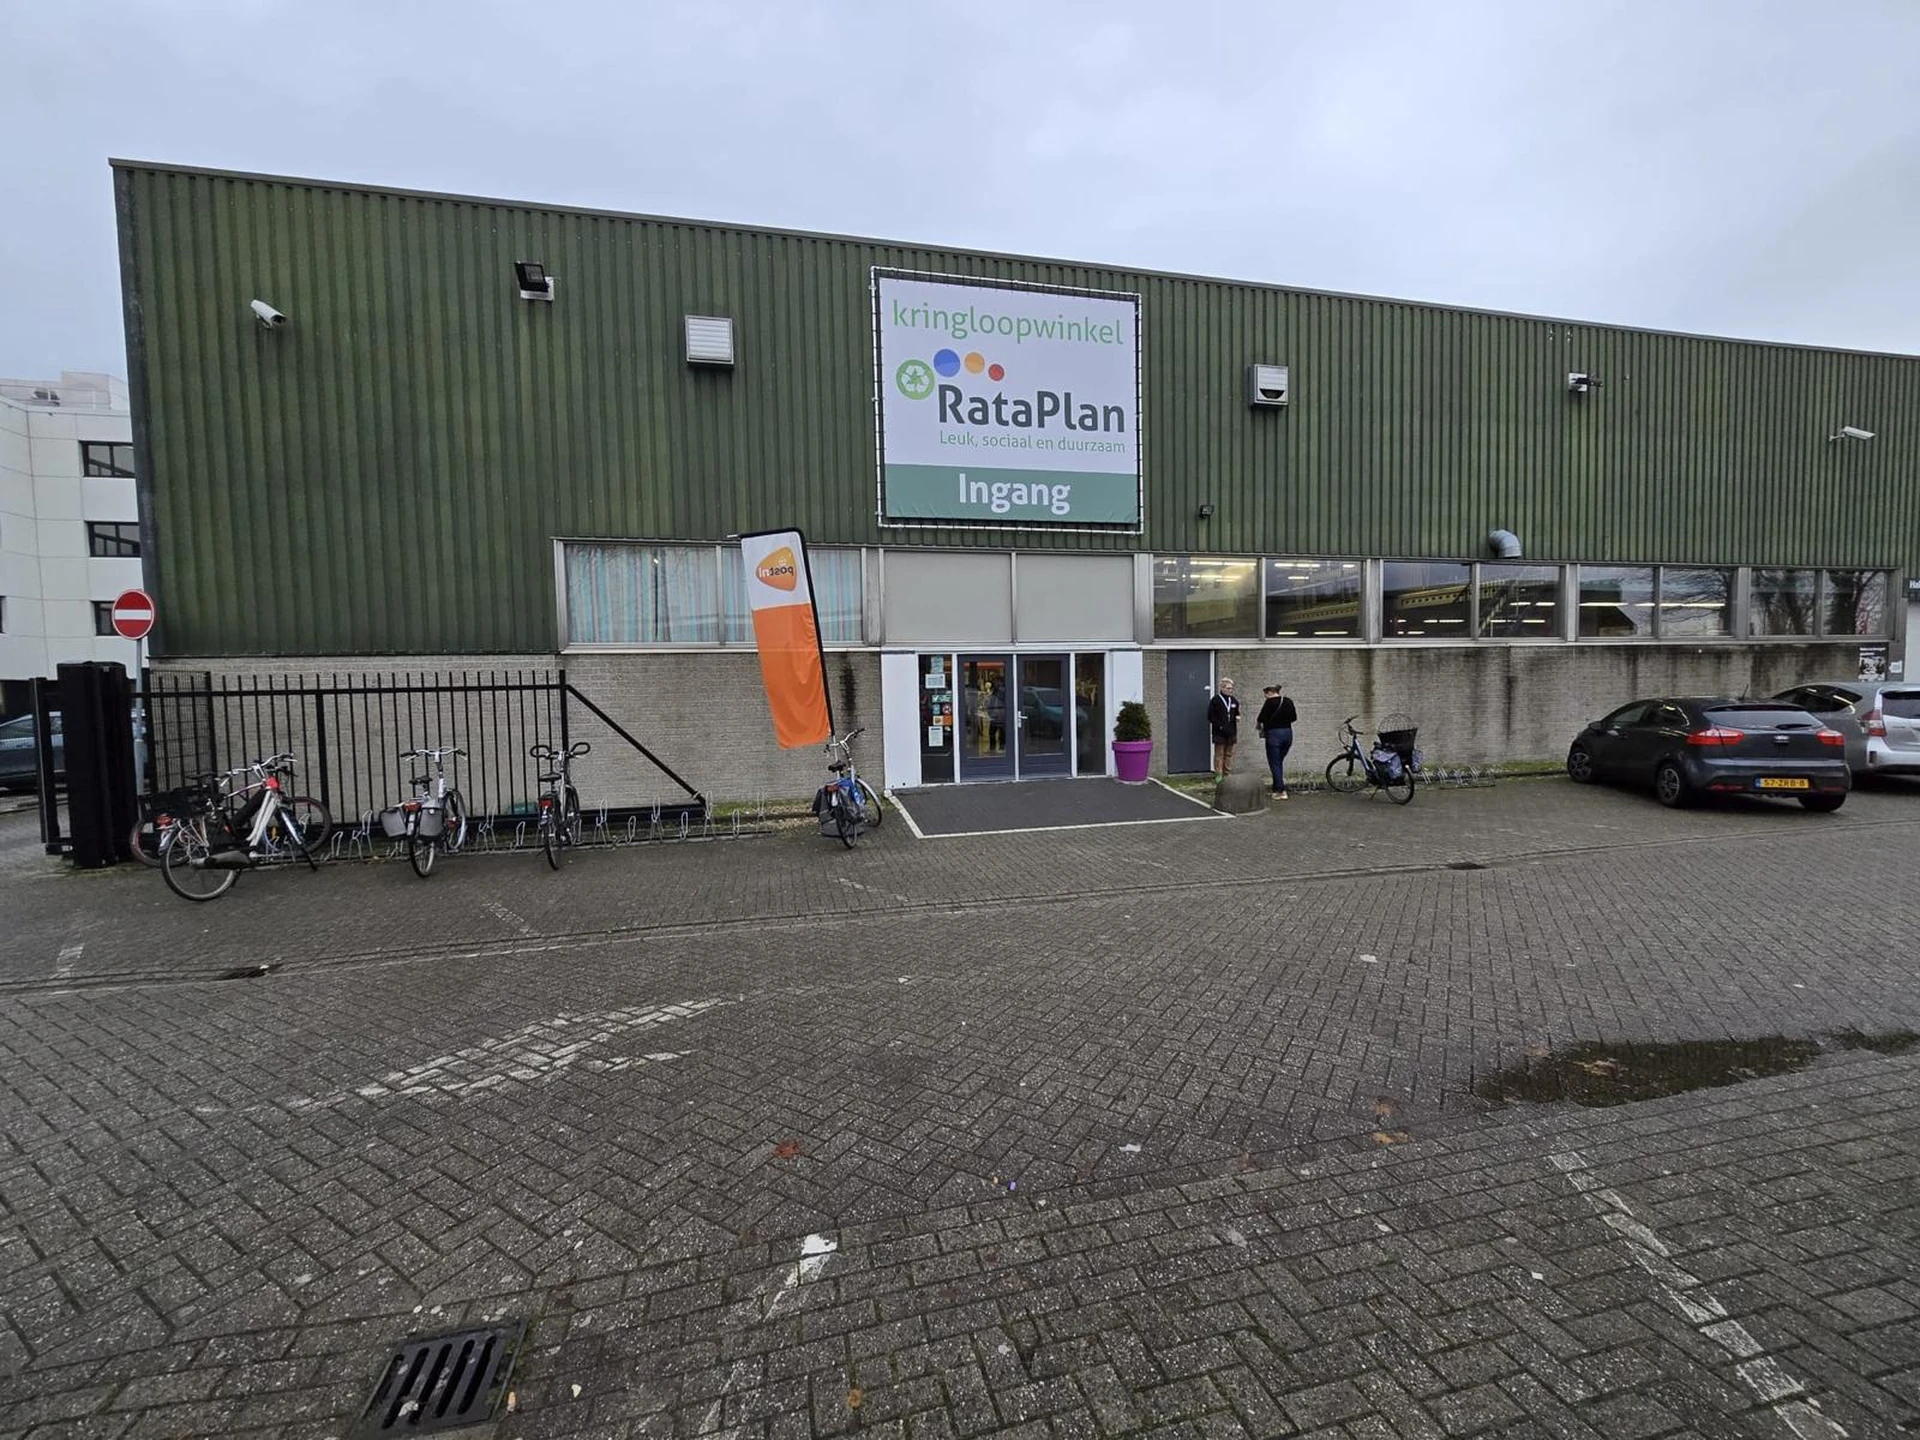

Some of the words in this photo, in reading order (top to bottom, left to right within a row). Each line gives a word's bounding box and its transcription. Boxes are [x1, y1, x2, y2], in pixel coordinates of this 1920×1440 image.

[893, 299, 1123, 345] kringloopwinkel
[938, 384, 1125, 433] RataPlan
[940, 430, 979, 448] Leuk,
[982, 435, 1032, 449] sociaal
[1036, 440, 1054, 450] en
[1058, 440, 1126, 453] duurzaam
[958, 473, 1071, 515] Ingang
